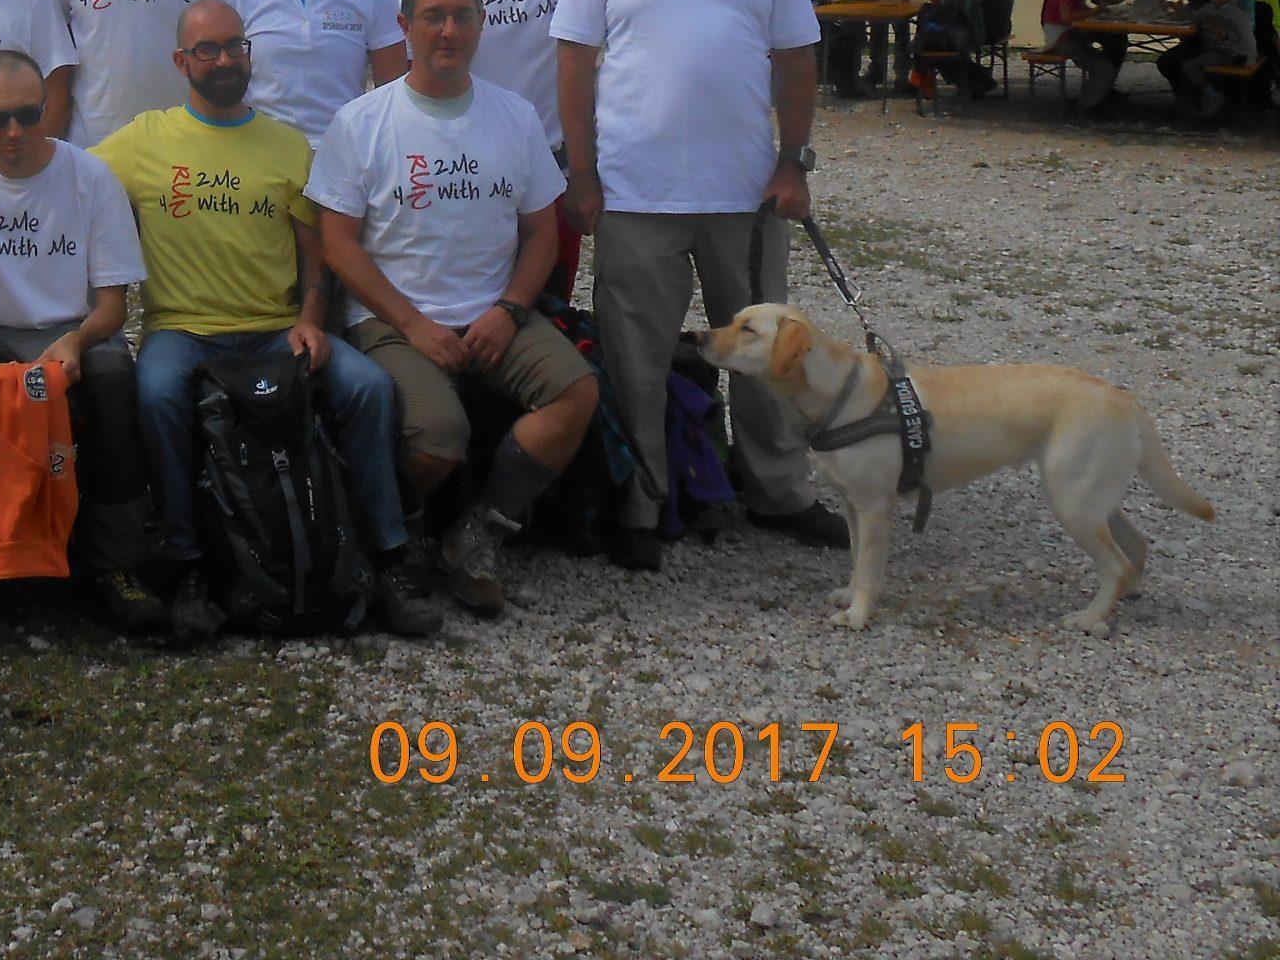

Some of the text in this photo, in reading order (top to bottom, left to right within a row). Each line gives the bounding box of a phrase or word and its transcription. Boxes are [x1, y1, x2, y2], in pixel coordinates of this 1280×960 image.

[488, 7, 528, 26] With
[438, 176, 513, 201] With Me
[198, 193, 276, 218] With Me
[48, 234, 77, 256] Me
[895, 381, 923, 449] CANE GUIDA
